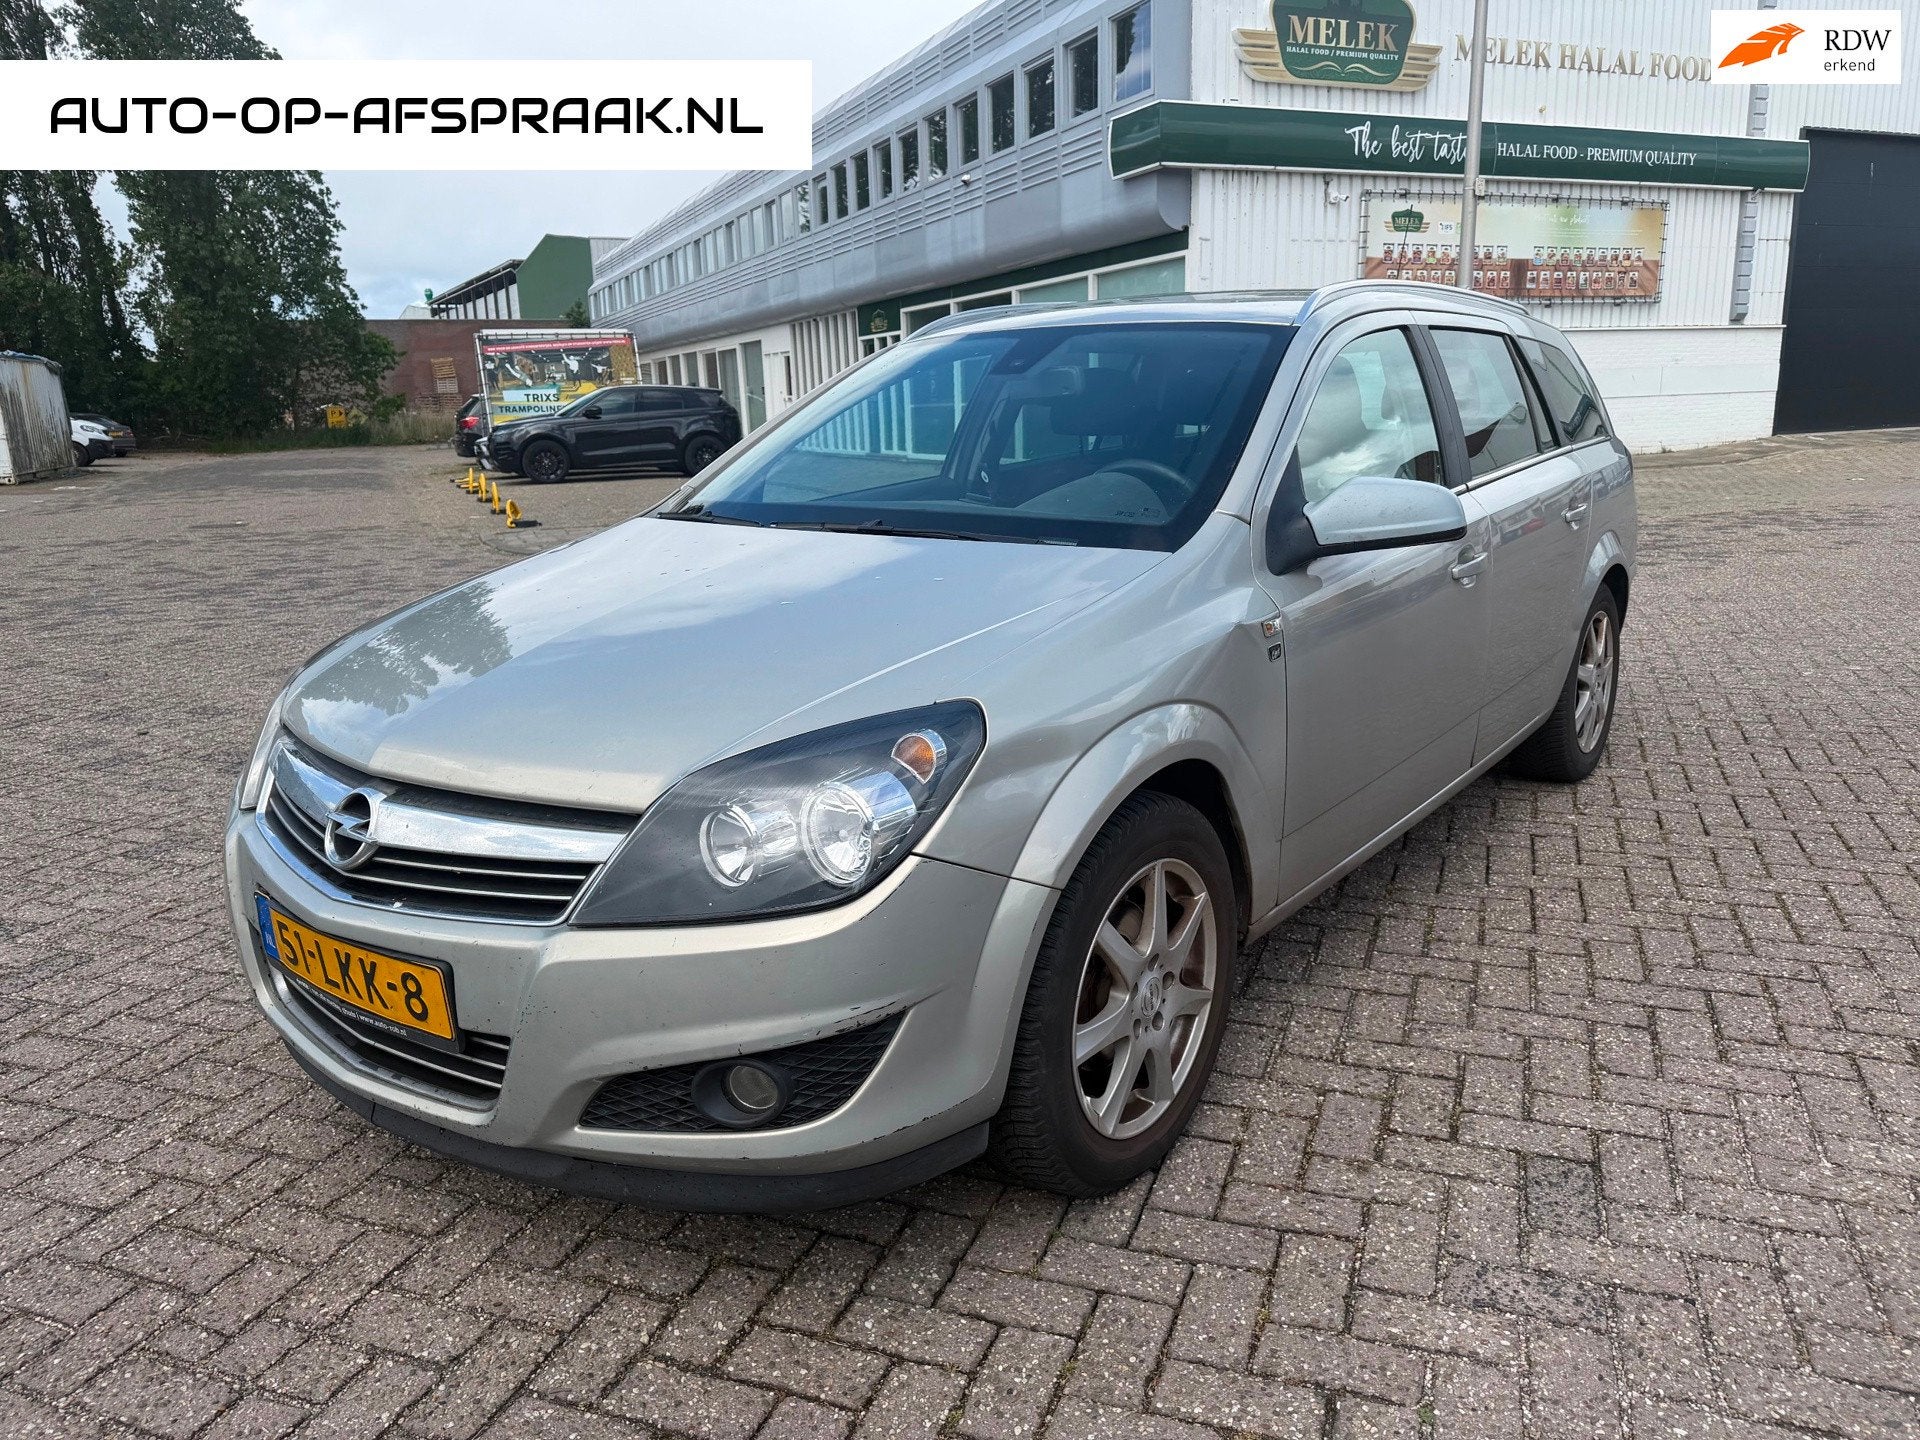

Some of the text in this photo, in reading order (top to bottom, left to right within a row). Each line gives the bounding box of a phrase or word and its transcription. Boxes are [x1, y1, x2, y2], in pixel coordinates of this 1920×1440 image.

[1286, 15, 1399, 51] MELEK
[1286, 46, 1310, 56] HALAL
[1311, 47, 1330, 57] FOOD
[1336, 50, 1368, 59] PREMIUM
[1369, 52, 1399, 61] QUALITY
[1558, 43, 1644, 77] HALAL
[1345, 120, 1382, 159] The
[1391, 124, 1425, 163] best
[1497, 142, 1541, 158] HALAL
[1543, 145, 1578, 160] FOOD
[1586, 147, 1643, 163] PREMIUM
[1645, 150, 1697, 166] QUALITY
[524, 393, 560, 403] TRIXS
[277, 919, 429, 1022] 51-LKK-8
